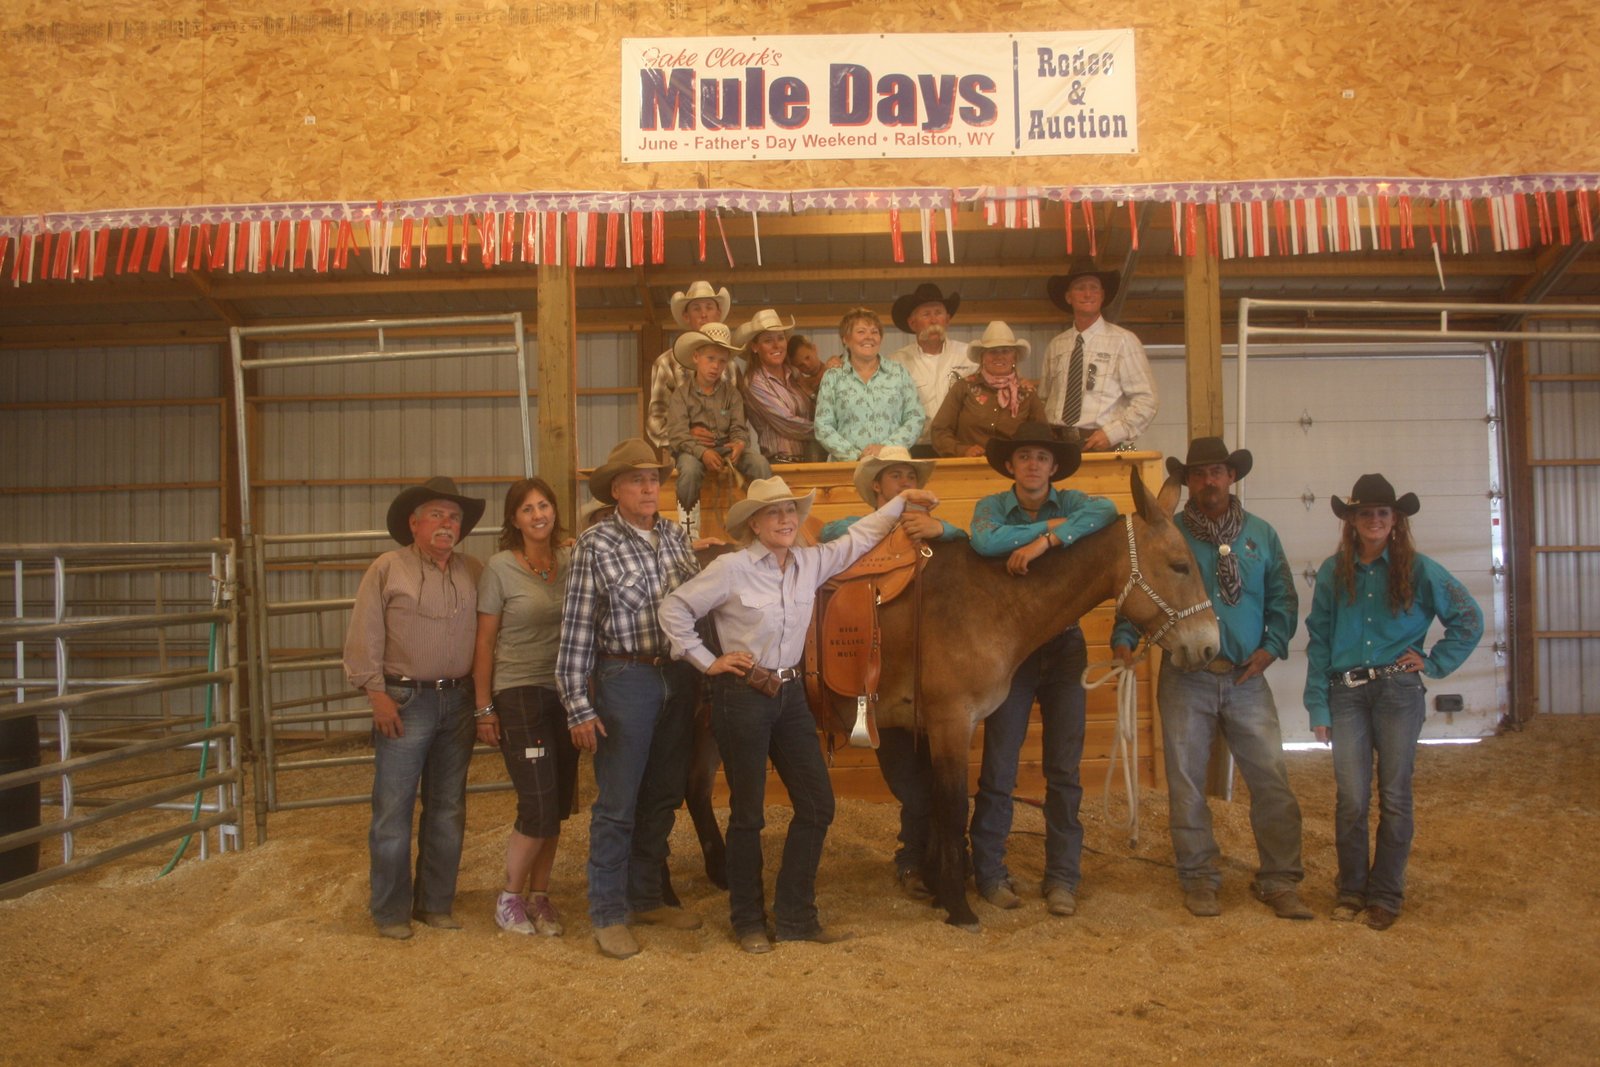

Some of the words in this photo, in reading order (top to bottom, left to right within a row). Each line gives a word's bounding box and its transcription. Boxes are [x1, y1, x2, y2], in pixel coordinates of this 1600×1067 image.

[641, 47, 698, 68] Jake
[704, 47, 783, 69] Clark's
[1037, 47, 1114, 78] Rodeo
[639, 67, 811, 131] Mule
[829, 63, 998, 133] Days
[1067, 80, 1086, 106] &
[1028, 108, 1128, 140] Auction
[638, 137, 678, 150] June
[695, 135, 760, 150] Father's
[766, 135, 797, 151] Day
[802, 132, 877, 148] Weekend
[894, 131, 962, 147] Ralston,
[967, 131, 994, 146] WY
